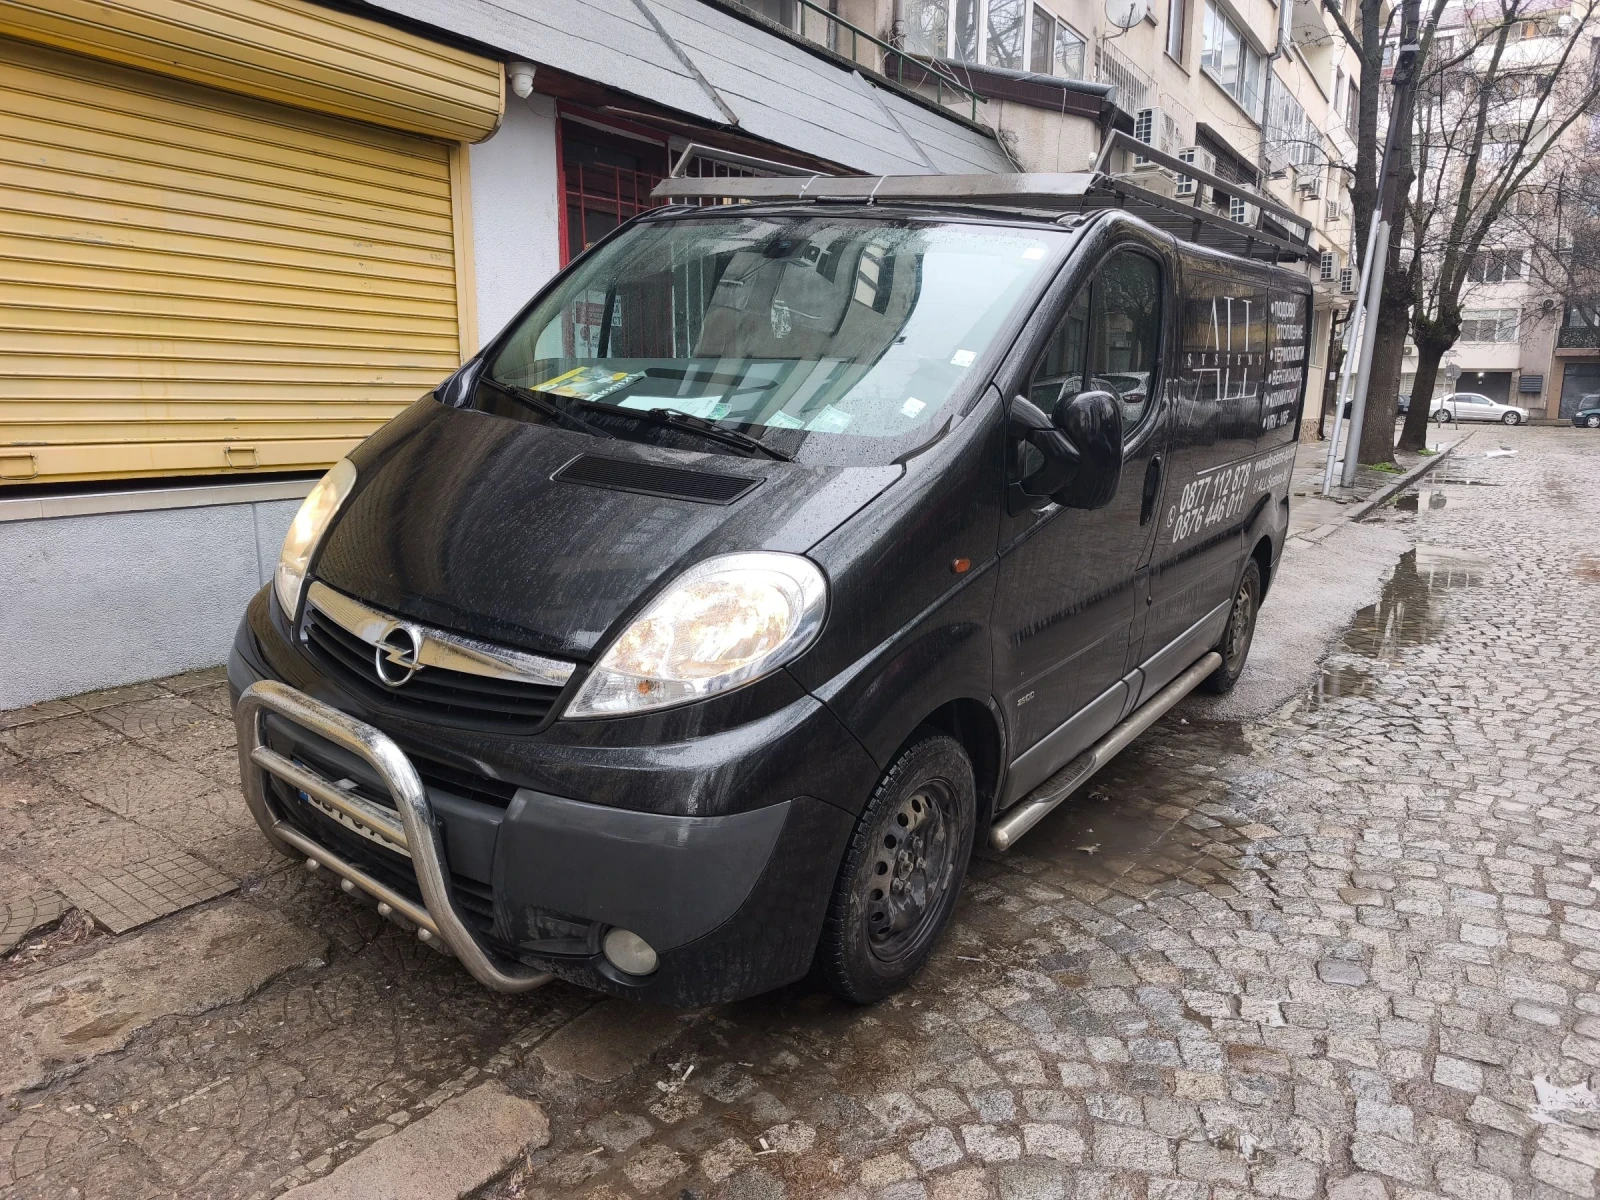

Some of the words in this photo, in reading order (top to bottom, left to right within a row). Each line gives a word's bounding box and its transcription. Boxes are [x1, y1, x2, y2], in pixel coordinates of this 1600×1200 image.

[1274, 300, 1296, 320] ПОДОВО
[1276, 323, 1304, 340] ОТОПЛЕНИЕ
[1187, 352, 1263, 367] SYSTEMS
[1179, 475, 1212, 513] 0877
[1212, 468, 1232, 499] 112
[1231, 462, 1252, 493] 878
[1172, 505, 1205, 544] 0876
[1204, 496, 1227, 528] 446
[1225, 488, 1246, 519] 011
[1016, 690, 1036, 707] 2500
